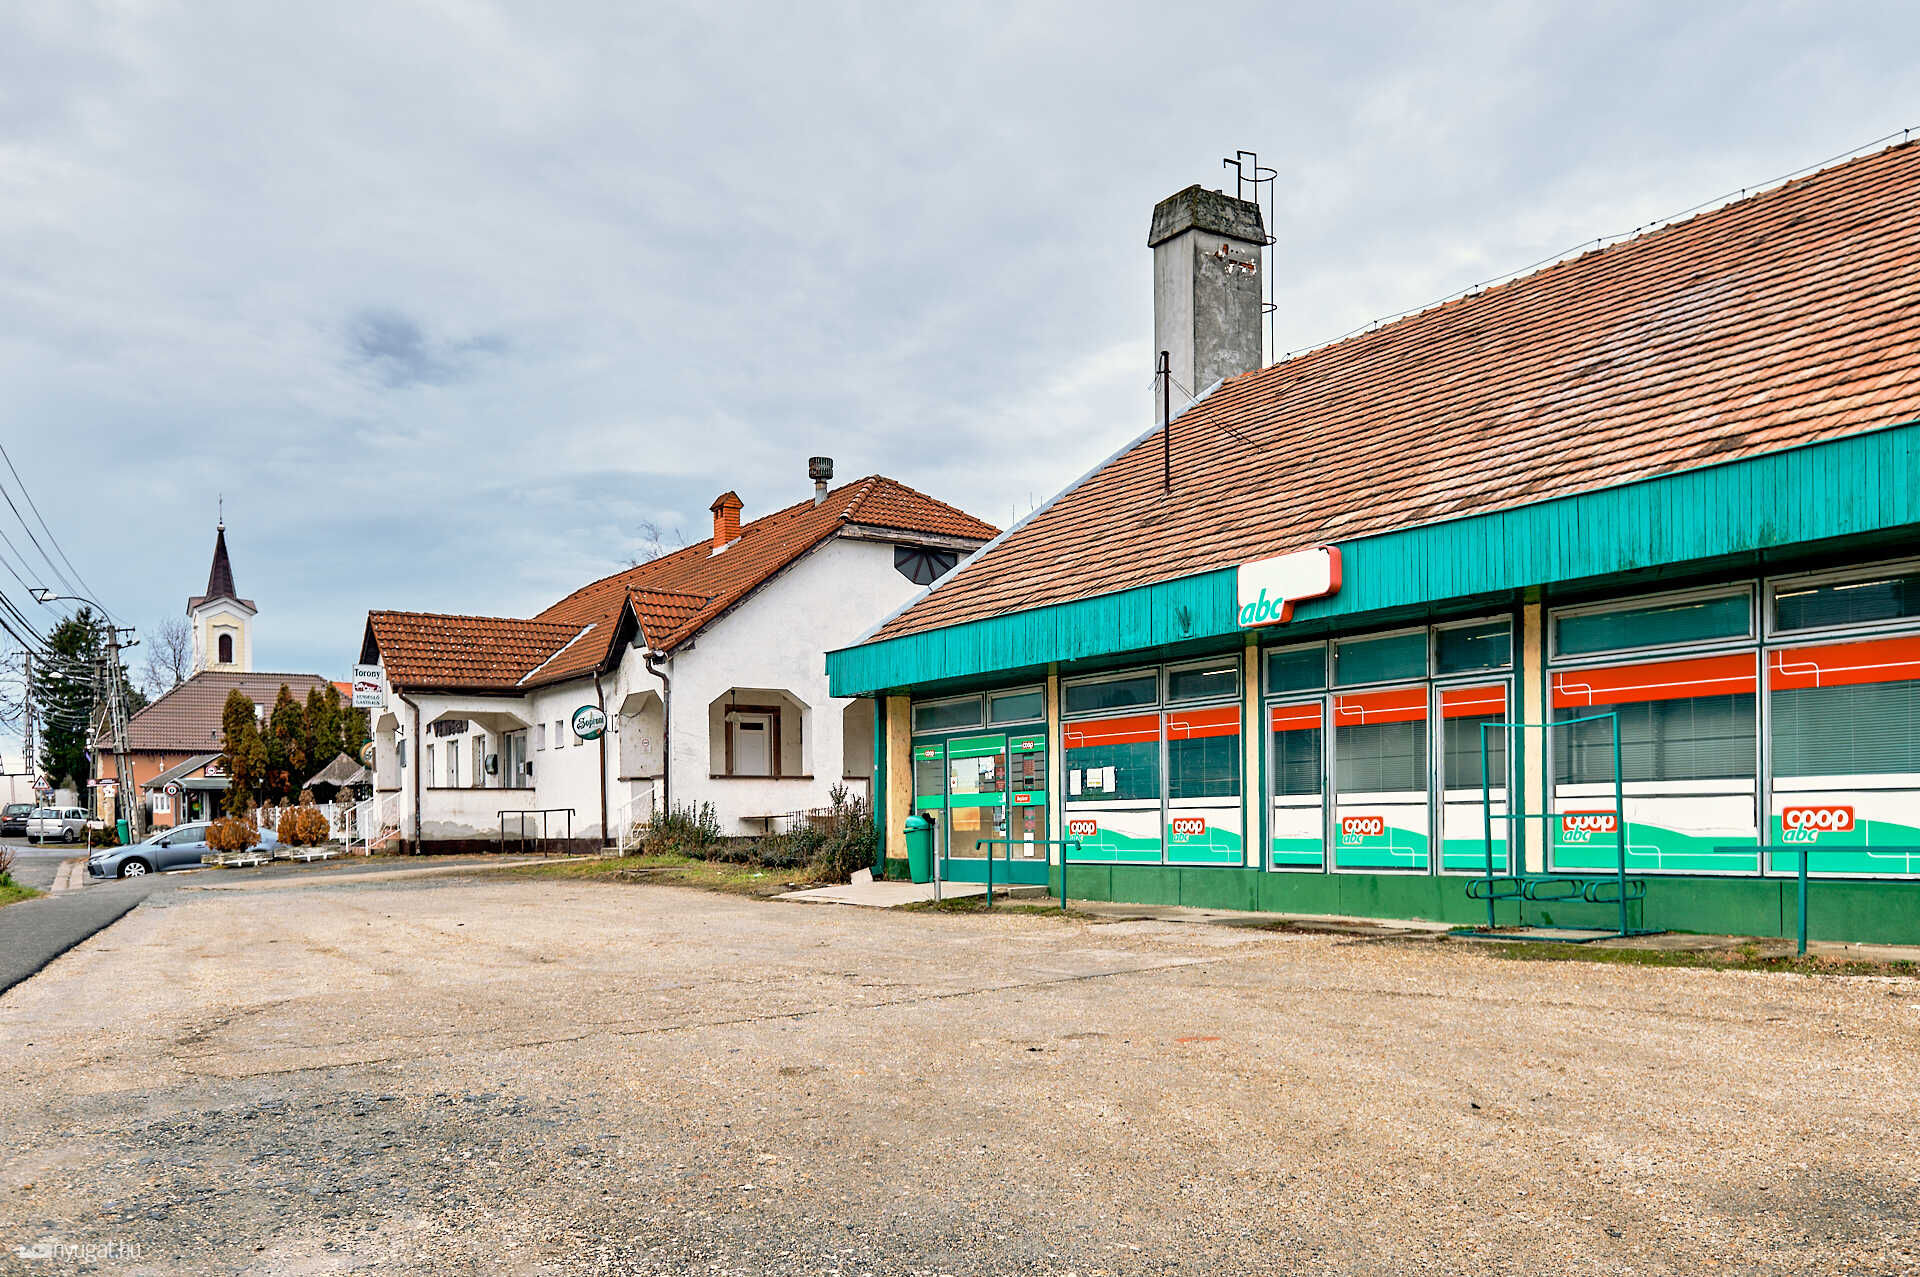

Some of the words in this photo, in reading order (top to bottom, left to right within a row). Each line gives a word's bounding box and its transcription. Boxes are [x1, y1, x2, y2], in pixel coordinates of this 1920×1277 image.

[1240, 588, 1284, 625] abc
[354, 668, 381, 679] Torony
[1071, 821, 1095, 835] coop
[1174, 820, 1203, 834] coop
[1345, 819, 1381, 835] coop
[1566, 815, 1614, 832] coop
[1786, 809, 1849, 832] coop
[1343, 829, 1363, 843] abc
[1563, 825, 1591, 841] abc
[1783, 823, 1818, 841] abc
